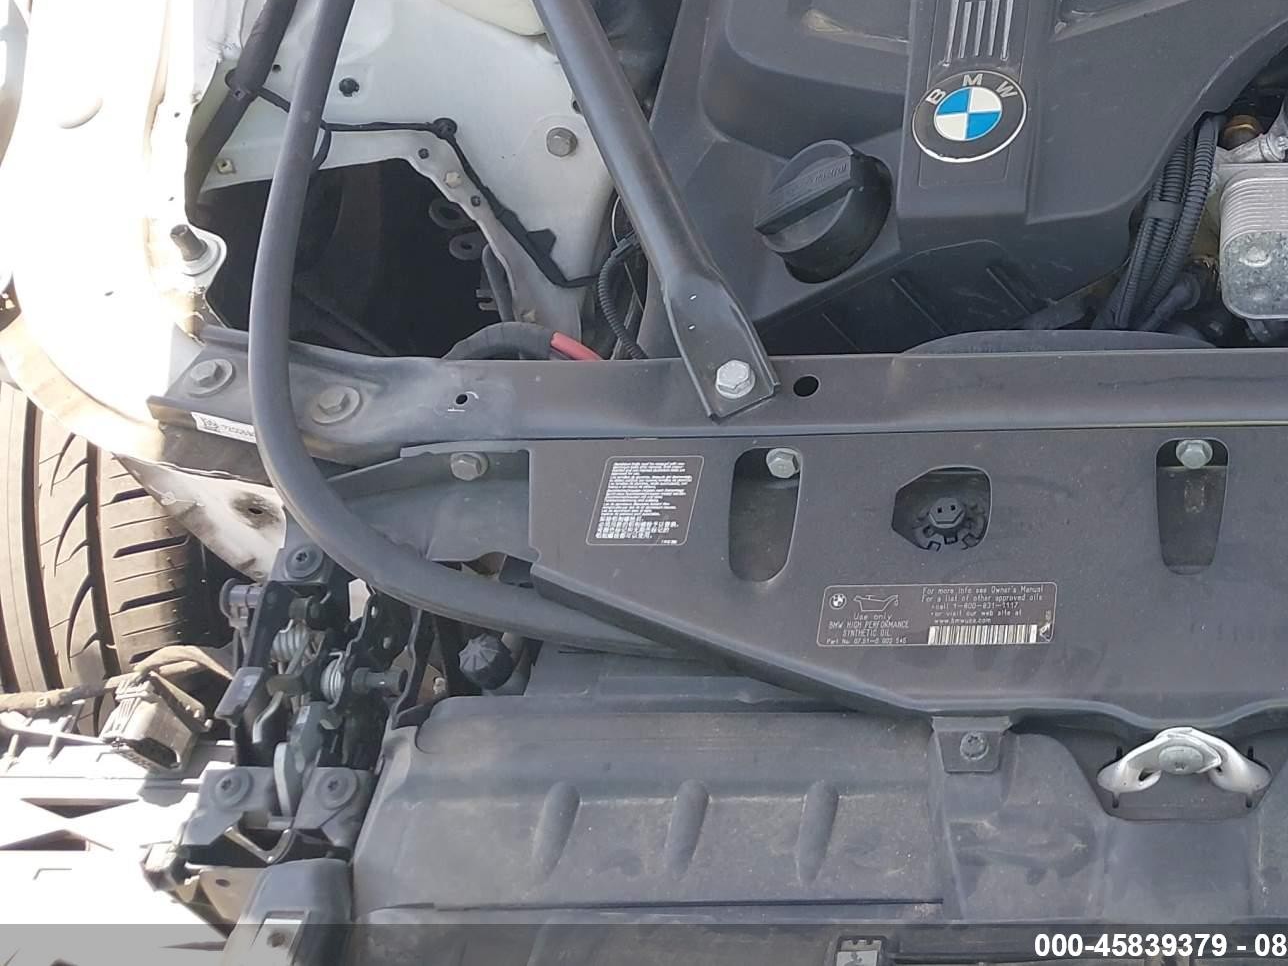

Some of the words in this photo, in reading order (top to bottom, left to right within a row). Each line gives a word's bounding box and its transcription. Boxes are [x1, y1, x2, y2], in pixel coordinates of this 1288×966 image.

[925, 73, 1018, 105] BMW
[922, 586, 934, 595] For
[1020, 584, 1044, 593] Manual
[995, 594, 1026, 602] approved
[873, 612, 893, 621] only
[846, 620, 862, 629] HIGH
[864, 620, 910, 629] PERFORMANCE
[842, 629, 877, 637] SYNTHETIC
[879, 629, 891, 637] OIL
